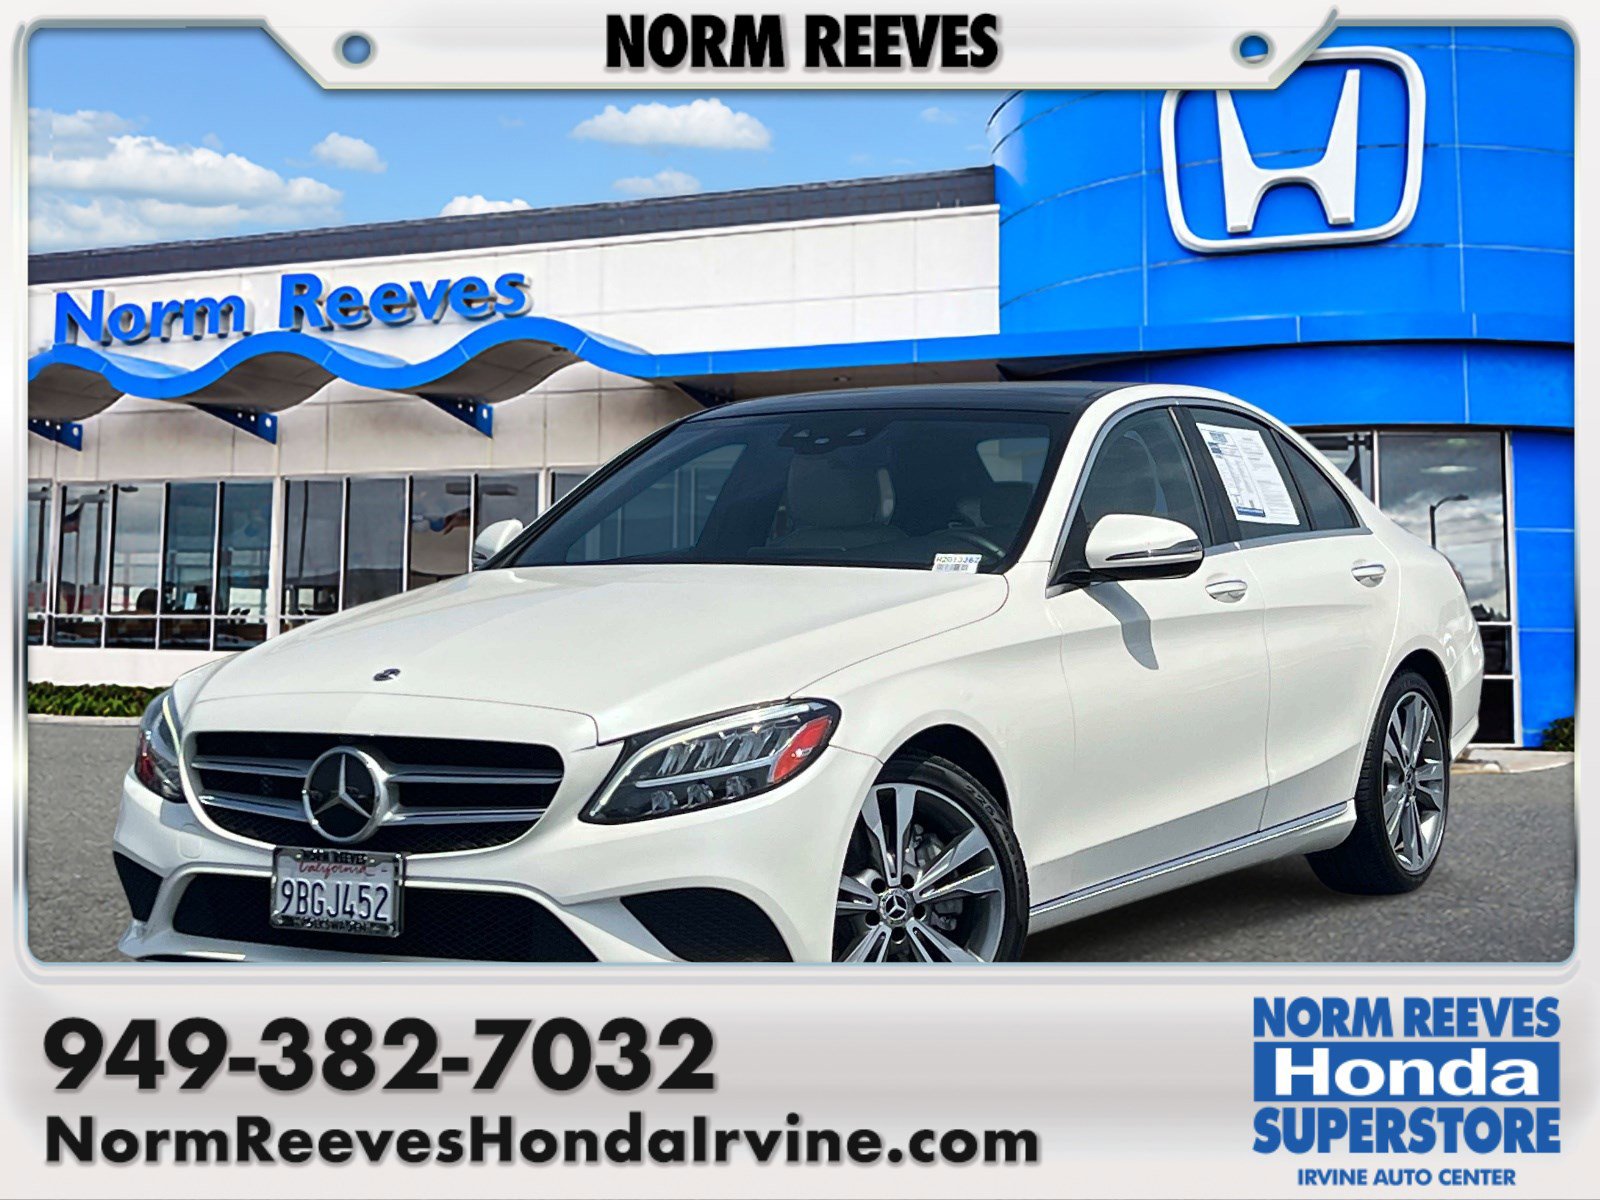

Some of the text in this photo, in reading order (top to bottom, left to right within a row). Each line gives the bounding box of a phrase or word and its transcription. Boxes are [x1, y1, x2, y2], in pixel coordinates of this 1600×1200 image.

[54, 272, 529, 345] Norm Reeves
[299, 860, 368, 878] California
[281, 879, 388, 922] 9BGJ452
